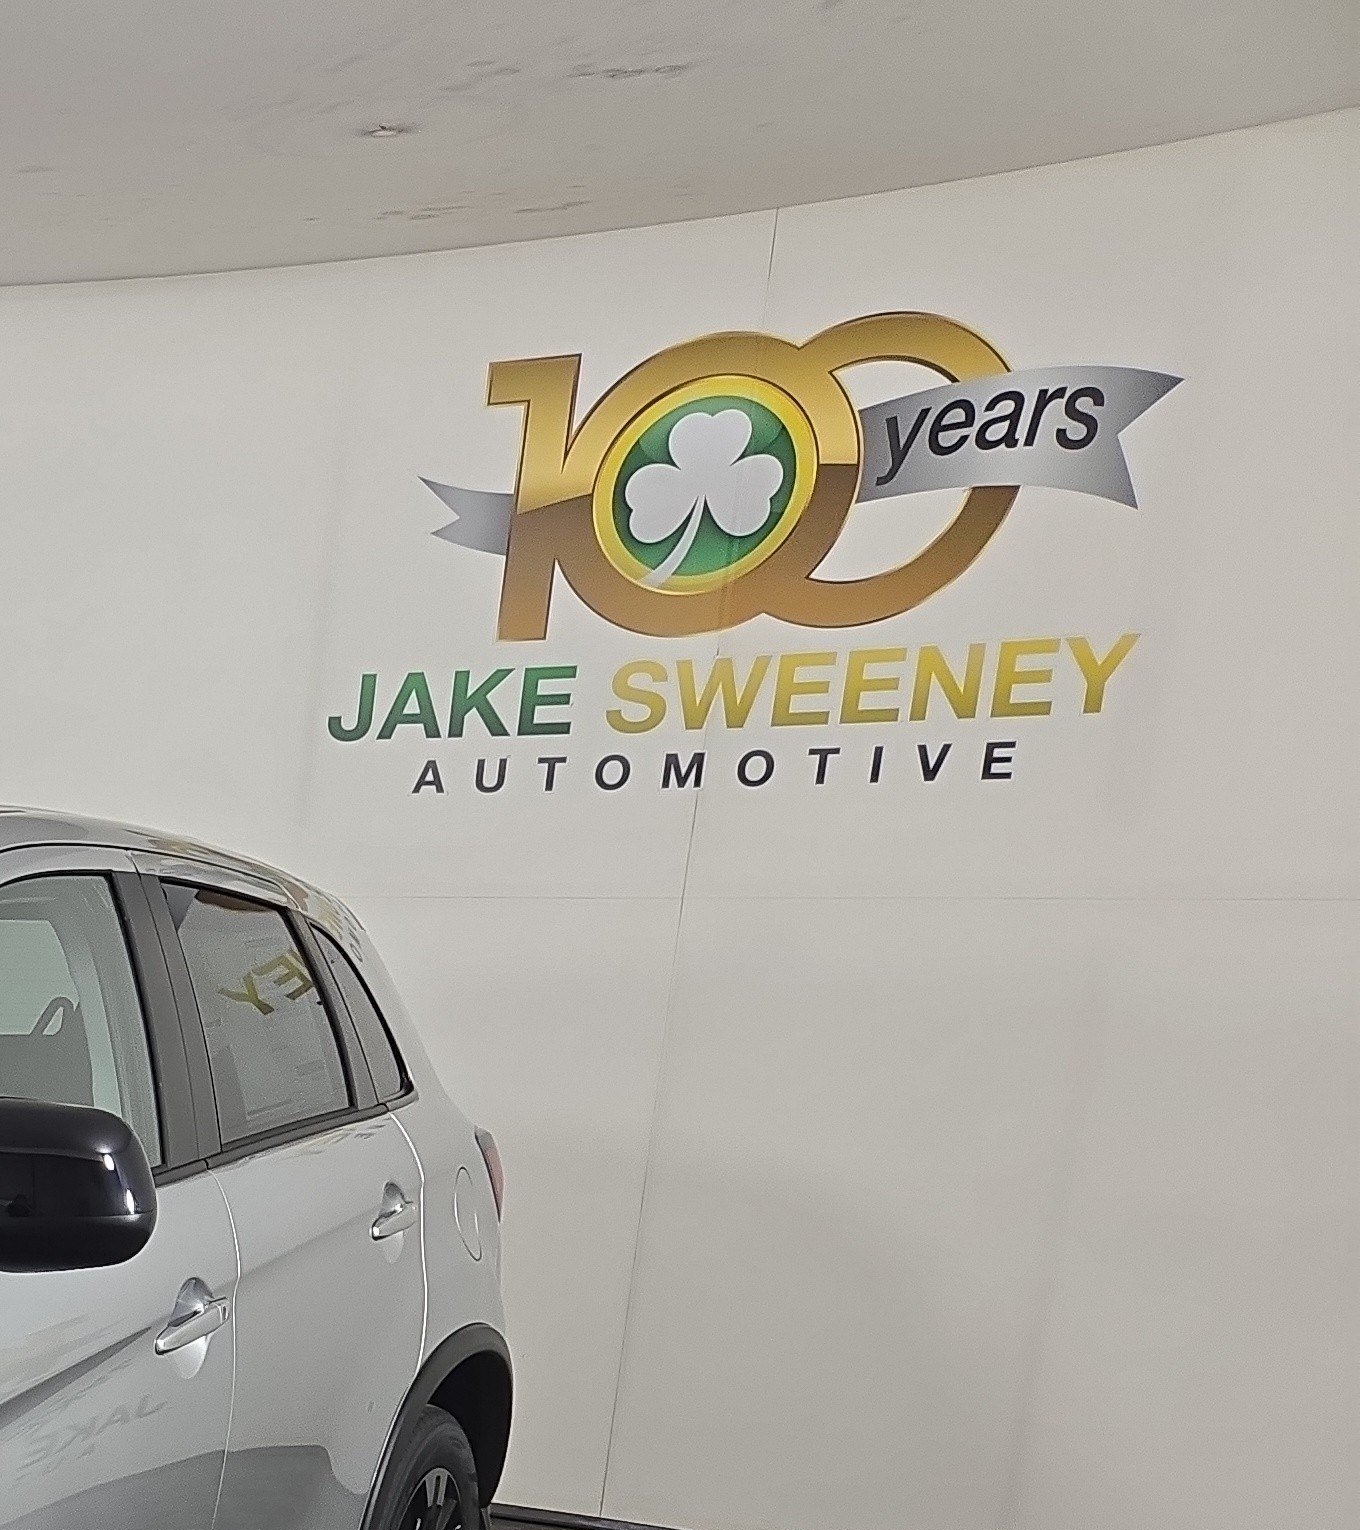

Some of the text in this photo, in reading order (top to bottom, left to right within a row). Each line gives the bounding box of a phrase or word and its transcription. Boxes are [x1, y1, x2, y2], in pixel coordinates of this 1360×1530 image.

[486, 311, 1105, 641] 100 years
[326, 632, 1141, 742] JAKE SWEENEY
[411, 740, 1017, 795] AUTOMOTIVE
